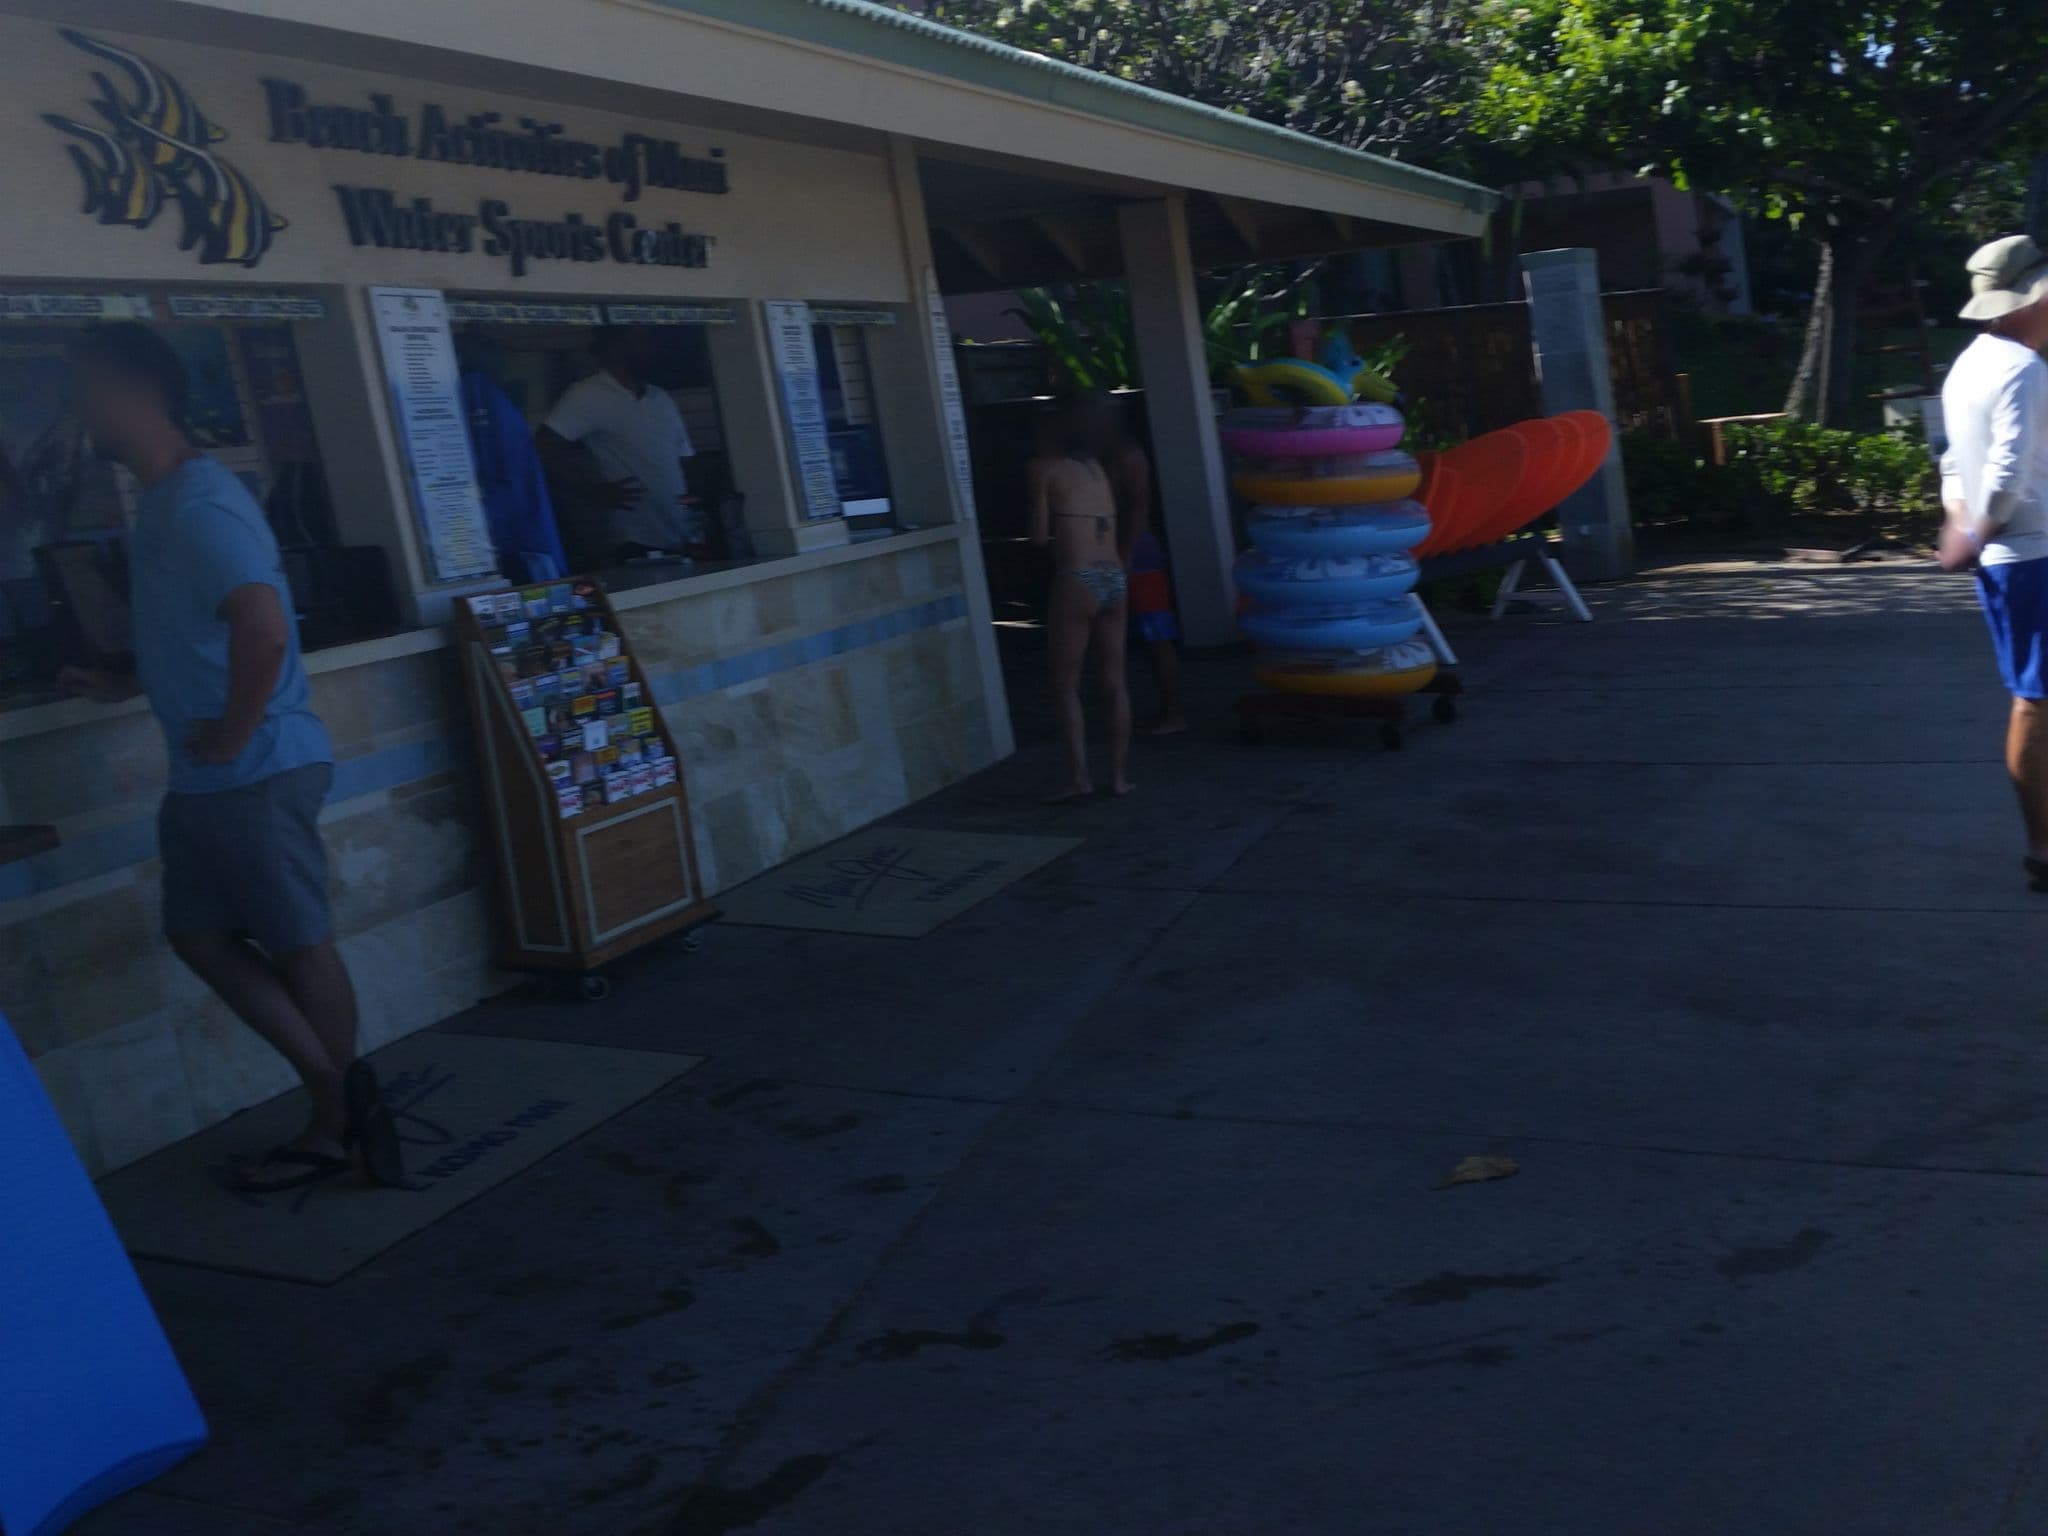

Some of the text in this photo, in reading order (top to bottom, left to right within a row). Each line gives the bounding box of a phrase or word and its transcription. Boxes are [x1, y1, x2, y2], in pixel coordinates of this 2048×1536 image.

[261, 79, 729, 201] Beach Activities of Maui
[331, 184, 716, 277] Water Sports Center
